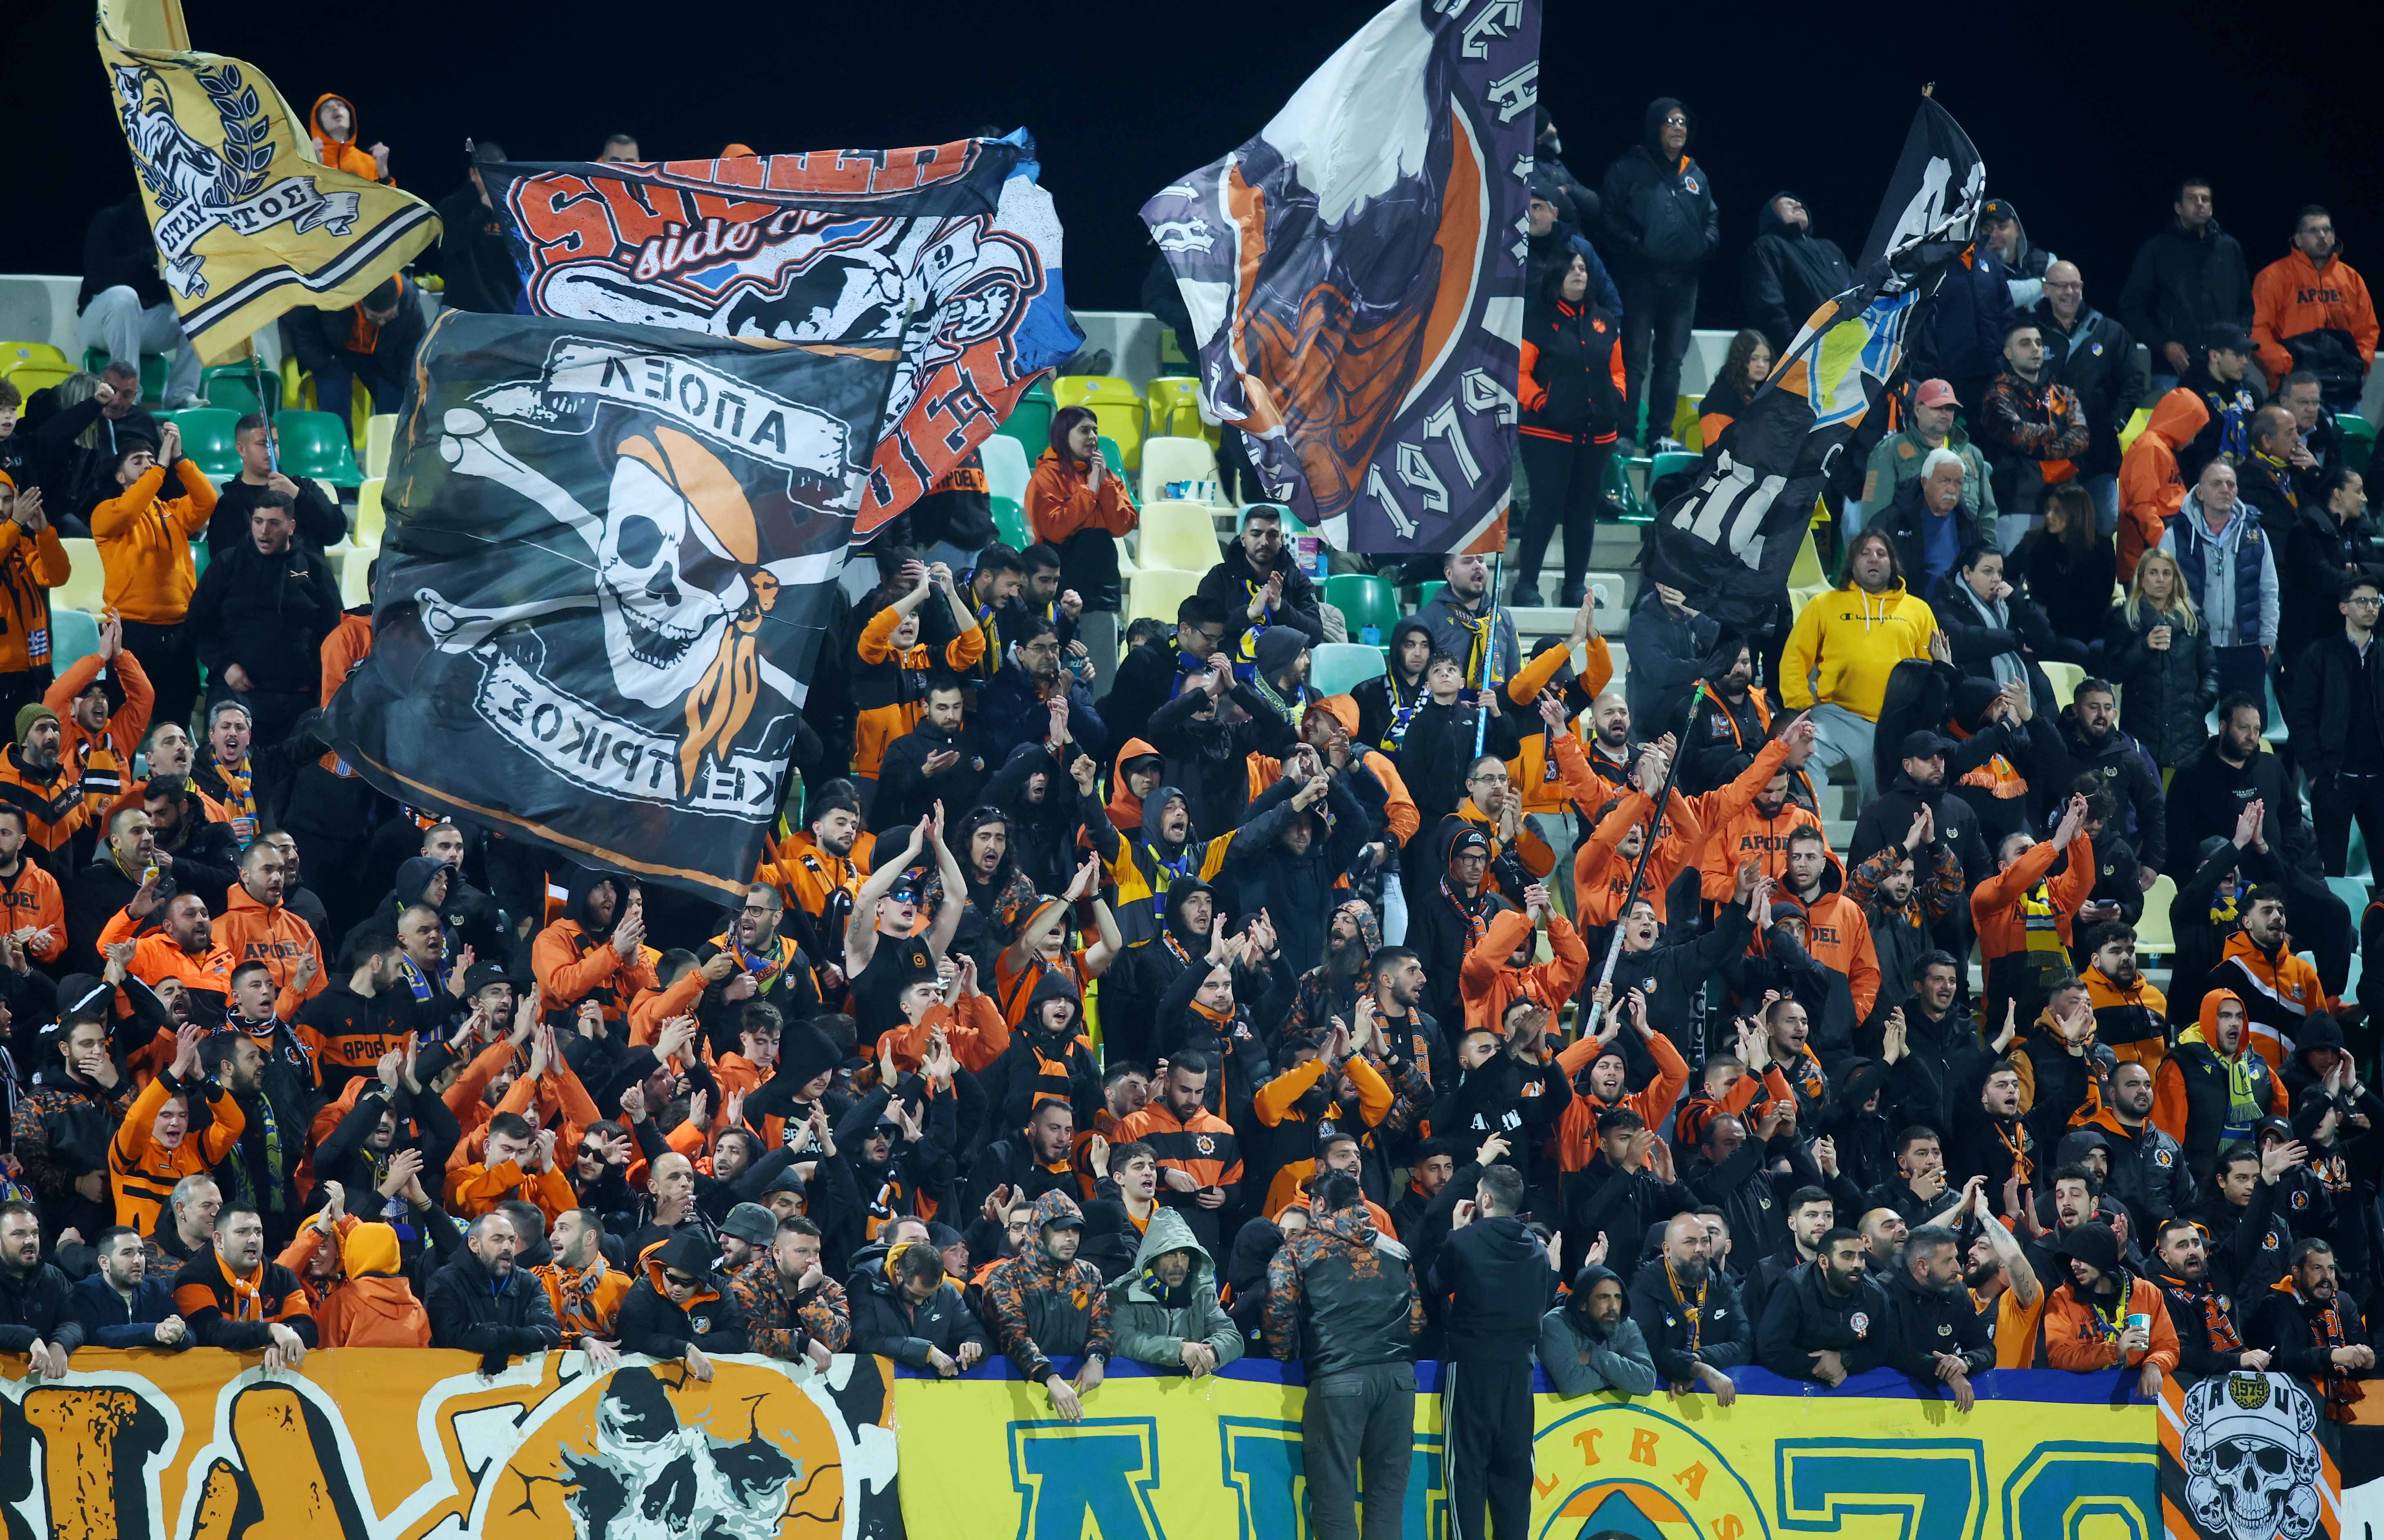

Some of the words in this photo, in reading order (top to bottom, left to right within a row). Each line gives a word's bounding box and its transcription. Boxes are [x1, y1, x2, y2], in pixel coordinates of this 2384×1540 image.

[633, 217, 760, 280] side
[1367, 366, 1514, 540] 1979
[1840, 613, 1907, 624] Champion
[1739, 835, 1790, 852] APOE
[2234, 1380, 2265, 1397] 1979
[1533, 1427, 1744, 1540] LTRAS
